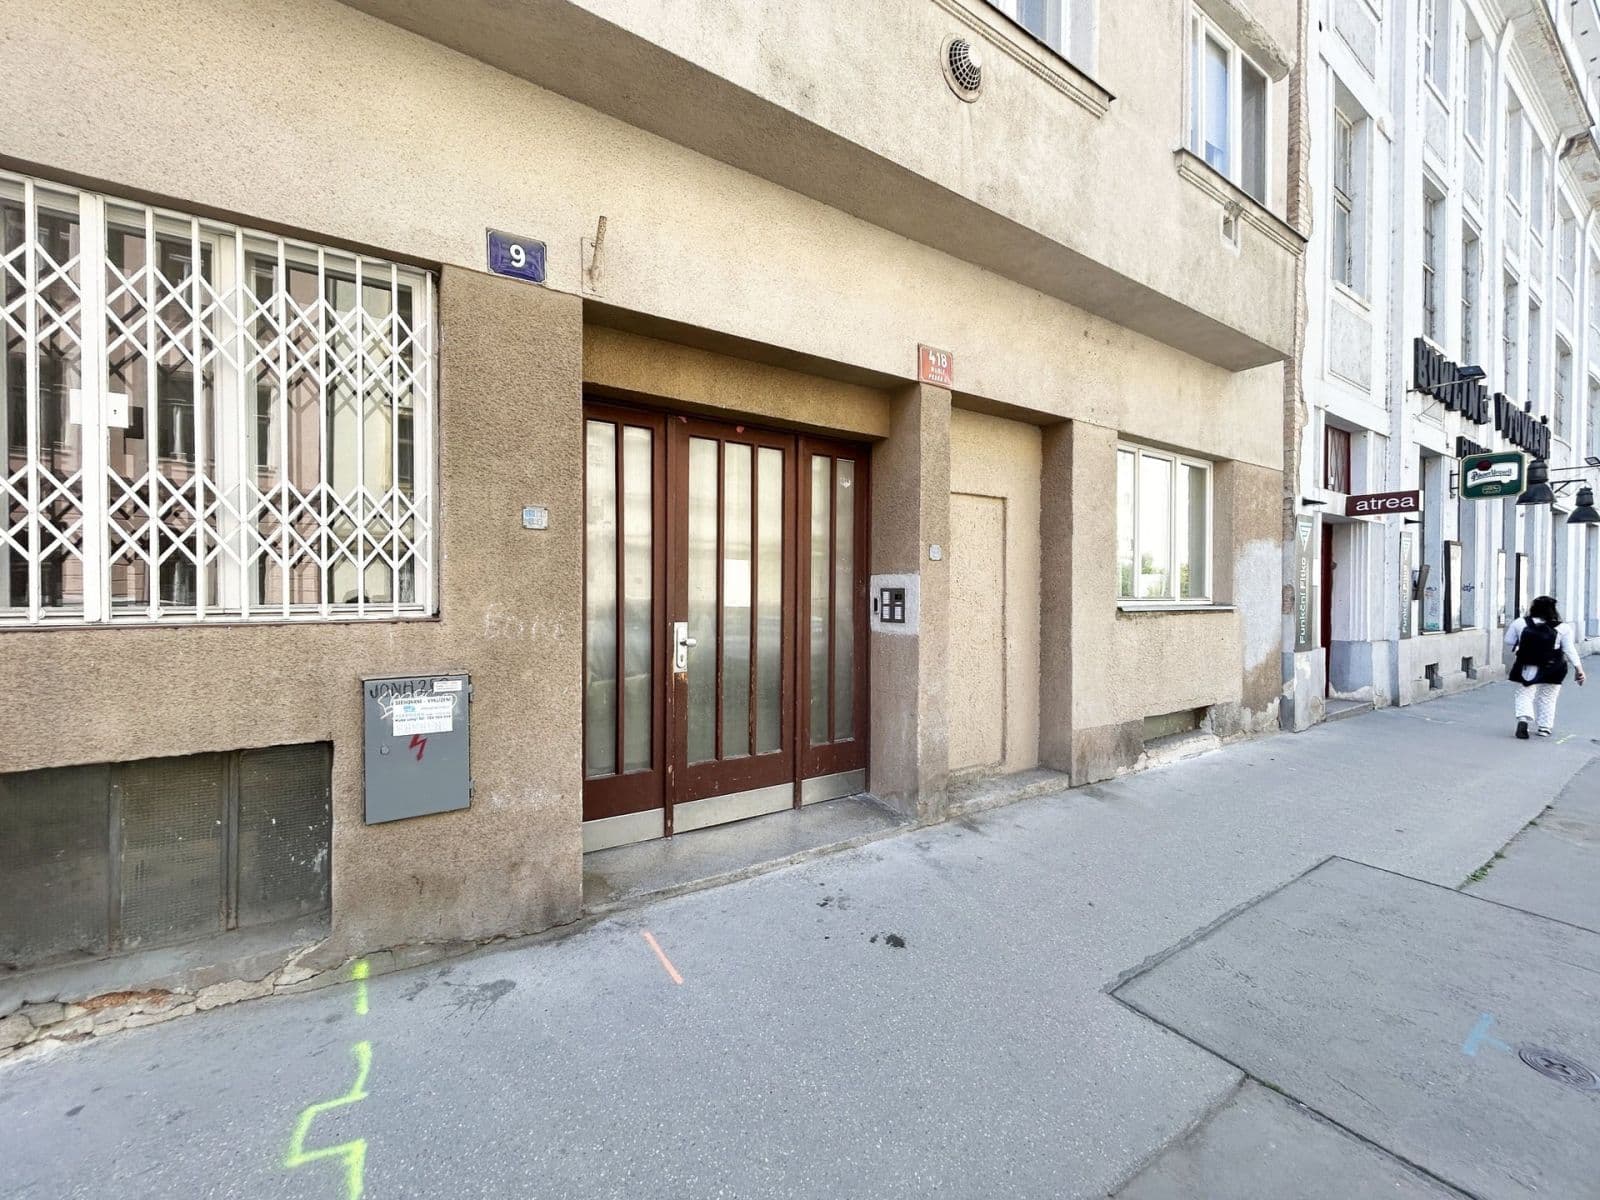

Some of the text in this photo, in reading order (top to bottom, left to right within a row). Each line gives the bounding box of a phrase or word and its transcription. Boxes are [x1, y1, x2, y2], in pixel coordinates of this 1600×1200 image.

[510, 244, 526, 268] 9
[929, 350, 947, 368] 418
[1355, 496, 1415, 511] atrea
